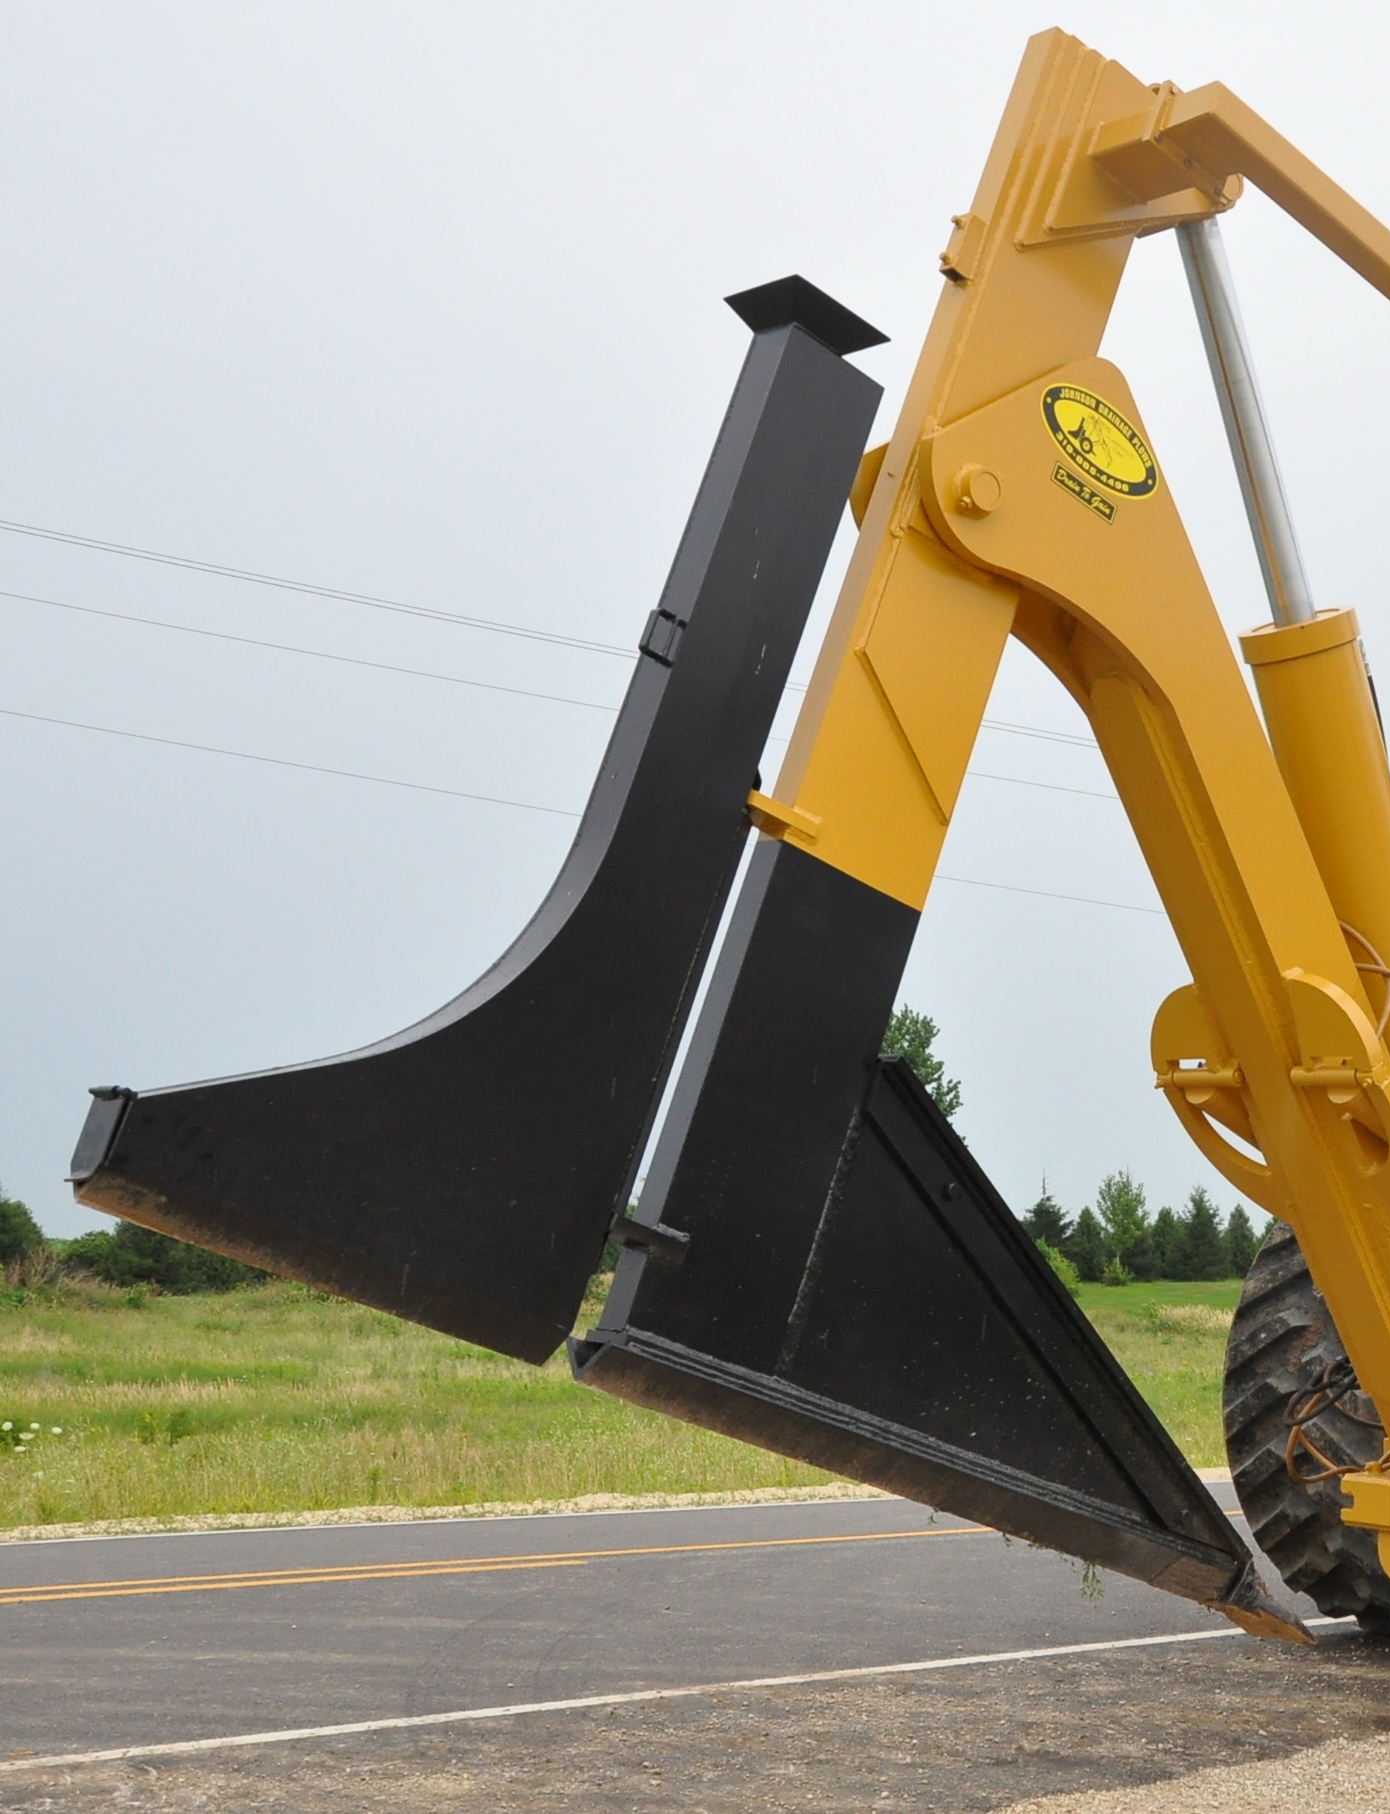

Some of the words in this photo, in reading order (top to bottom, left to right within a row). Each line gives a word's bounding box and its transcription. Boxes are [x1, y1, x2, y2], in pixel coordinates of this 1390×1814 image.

[1060, 387, 1097, 409] JOHNSON
[1098, 403, 1133, 439] DRAINAGE
[1131, 436, 1154, 469] PLOWS
[1056, 468, 1081, 492] Drain
[1080, 486, 1091, 500] To
[1091, 496, 1112, 517] Gain
